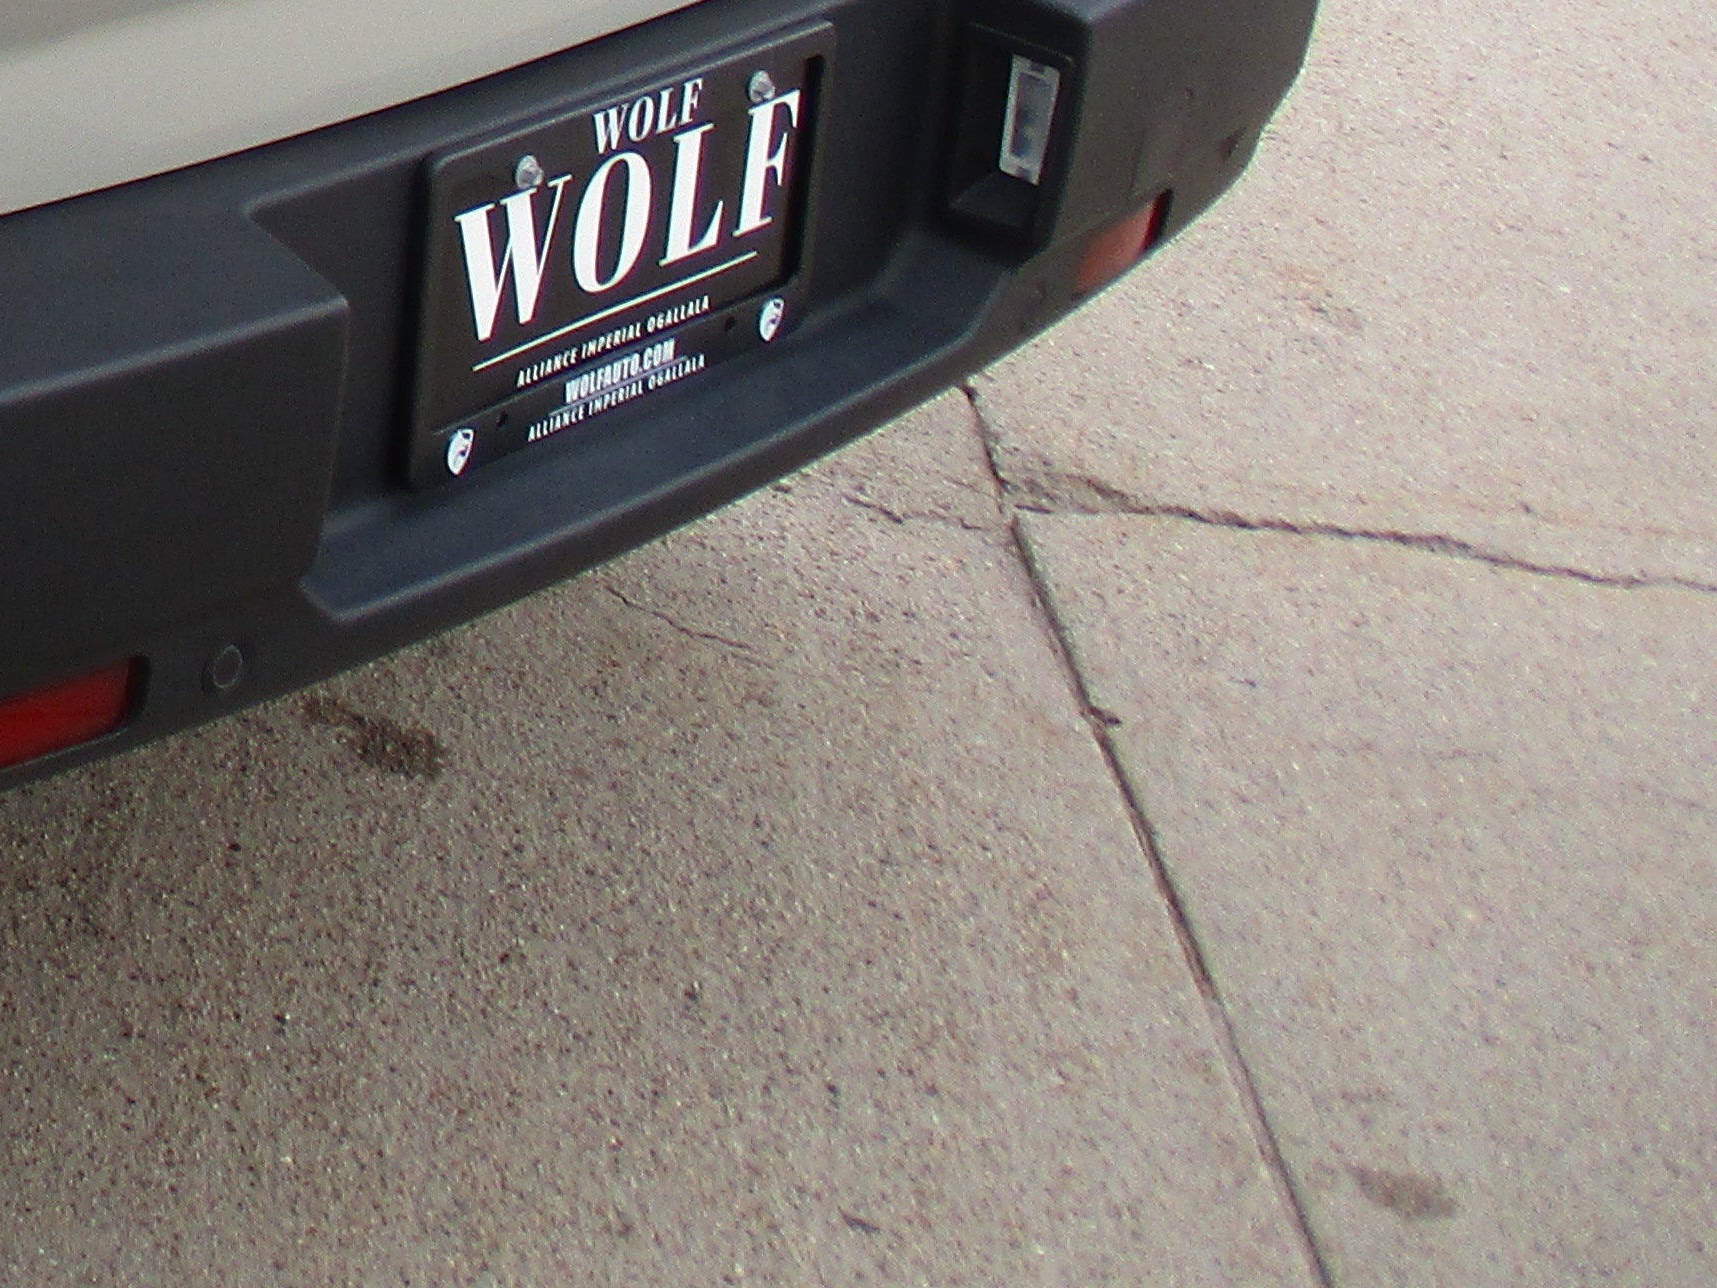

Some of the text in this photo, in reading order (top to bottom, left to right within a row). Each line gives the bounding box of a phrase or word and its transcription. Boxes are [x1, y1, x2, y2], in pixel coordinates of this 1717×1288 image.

[591, 77, 704, 155] WOLF
[453, 88, 802, 343] WOLF
[516, 294, 711, 390] ALLIANCE IMPERIAL OGALLALA
[564, 337, 677, 405] WOLFAUTO.COM
[527, 353, 706, 443] ALLIANCE IMPERIAL OGALLALA
